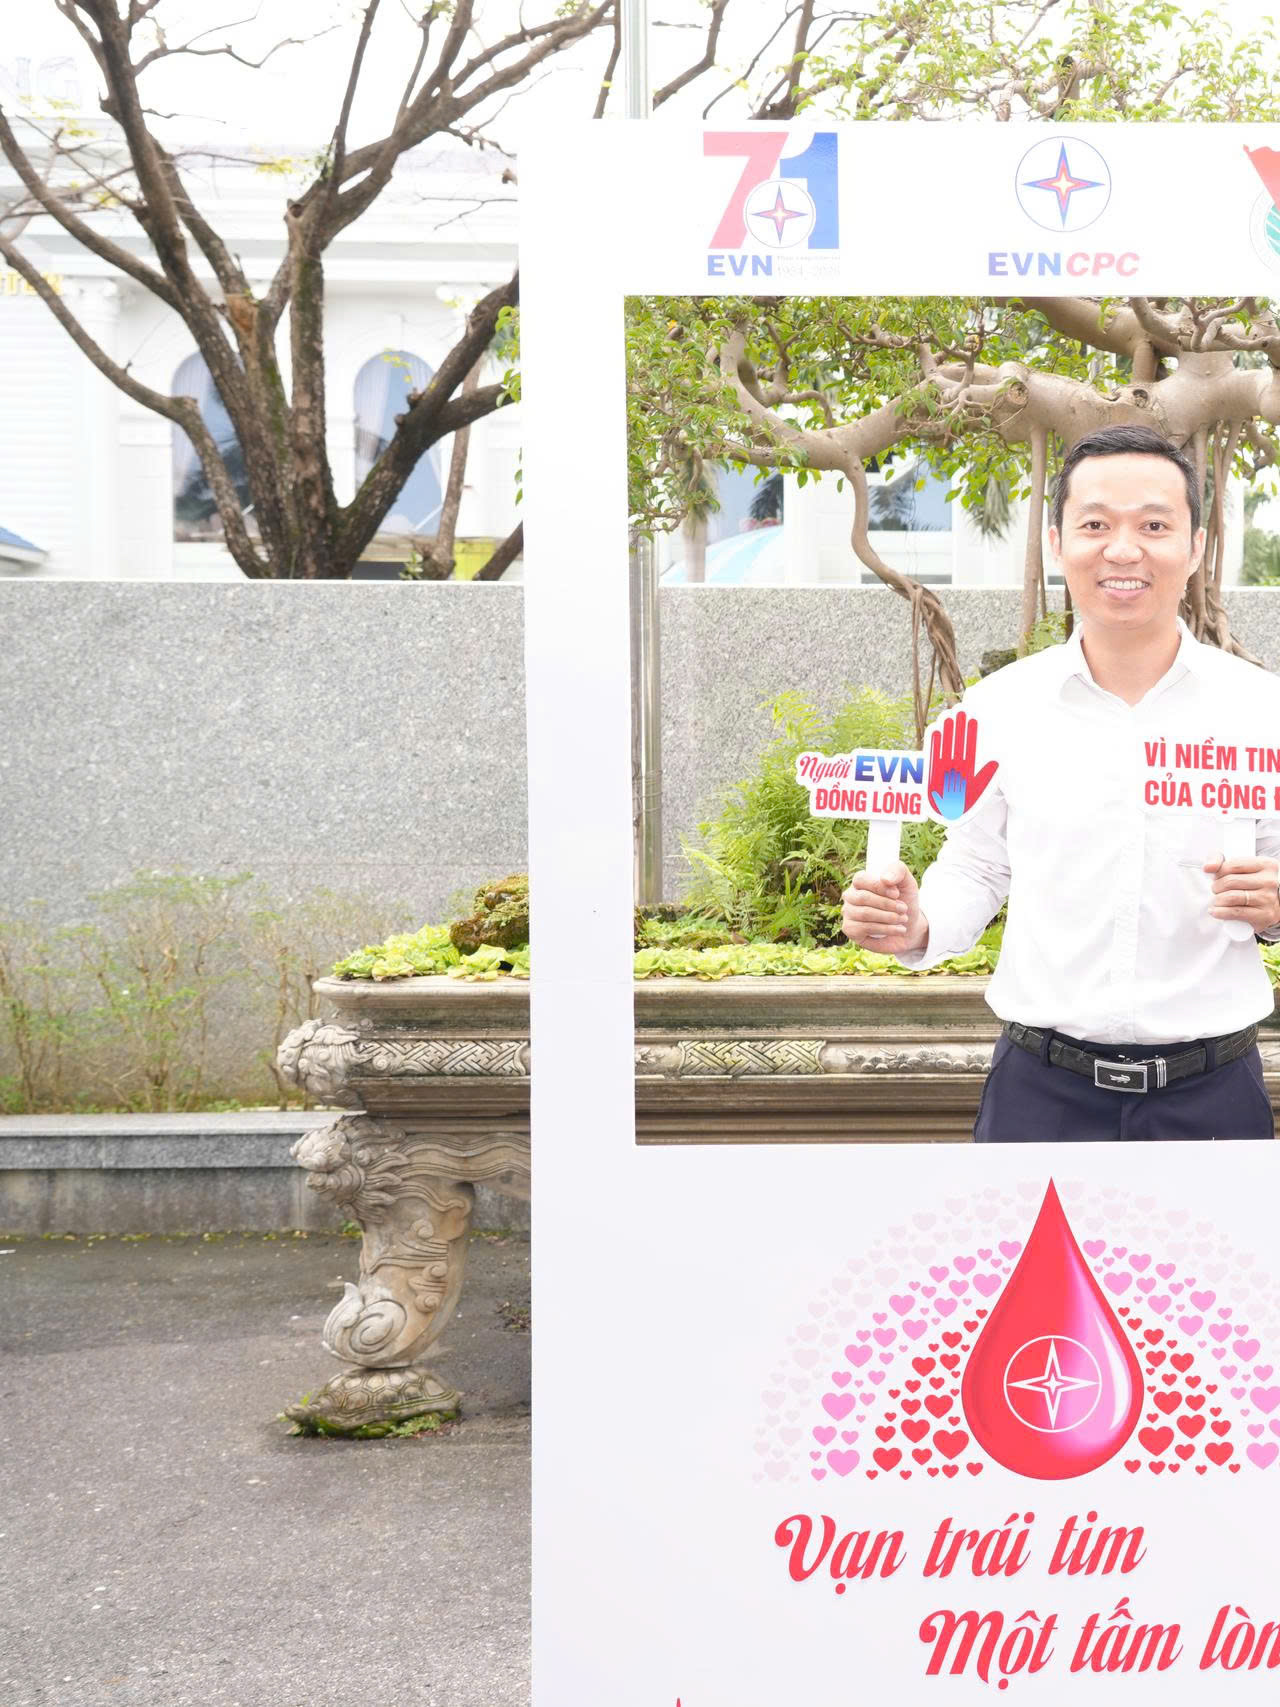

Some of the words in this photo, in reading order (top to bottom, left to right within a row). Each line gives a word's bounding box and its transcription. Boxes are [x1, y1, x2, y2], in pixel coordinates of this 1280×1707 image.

[707, 254, 773, 276] EVN
[988, 252, 1140, 277] EVNCPC
[799, 755, 853, 784] Người
[854, 755, 924, 784] EVN
[1144, 737, 1167, 768] VÌ
[1175, 736, 1237, 771] NIỀM
[815, 781, 867, 813] ĐỒNG
[872, 786, 922, 815] LÒNG
[1144, 772, 1193, 807] CỦA
[1201, 779, 1266, 815] CỘNG
[774, 1514, 907, 1595] Vạn
[922, 1511, 1035, 1578] trái
[1047, 1510, 1147, 1576] tim
[918, 1609, 1058, 1690] Một
[1069, 1597, 1183, 1673] tấm
